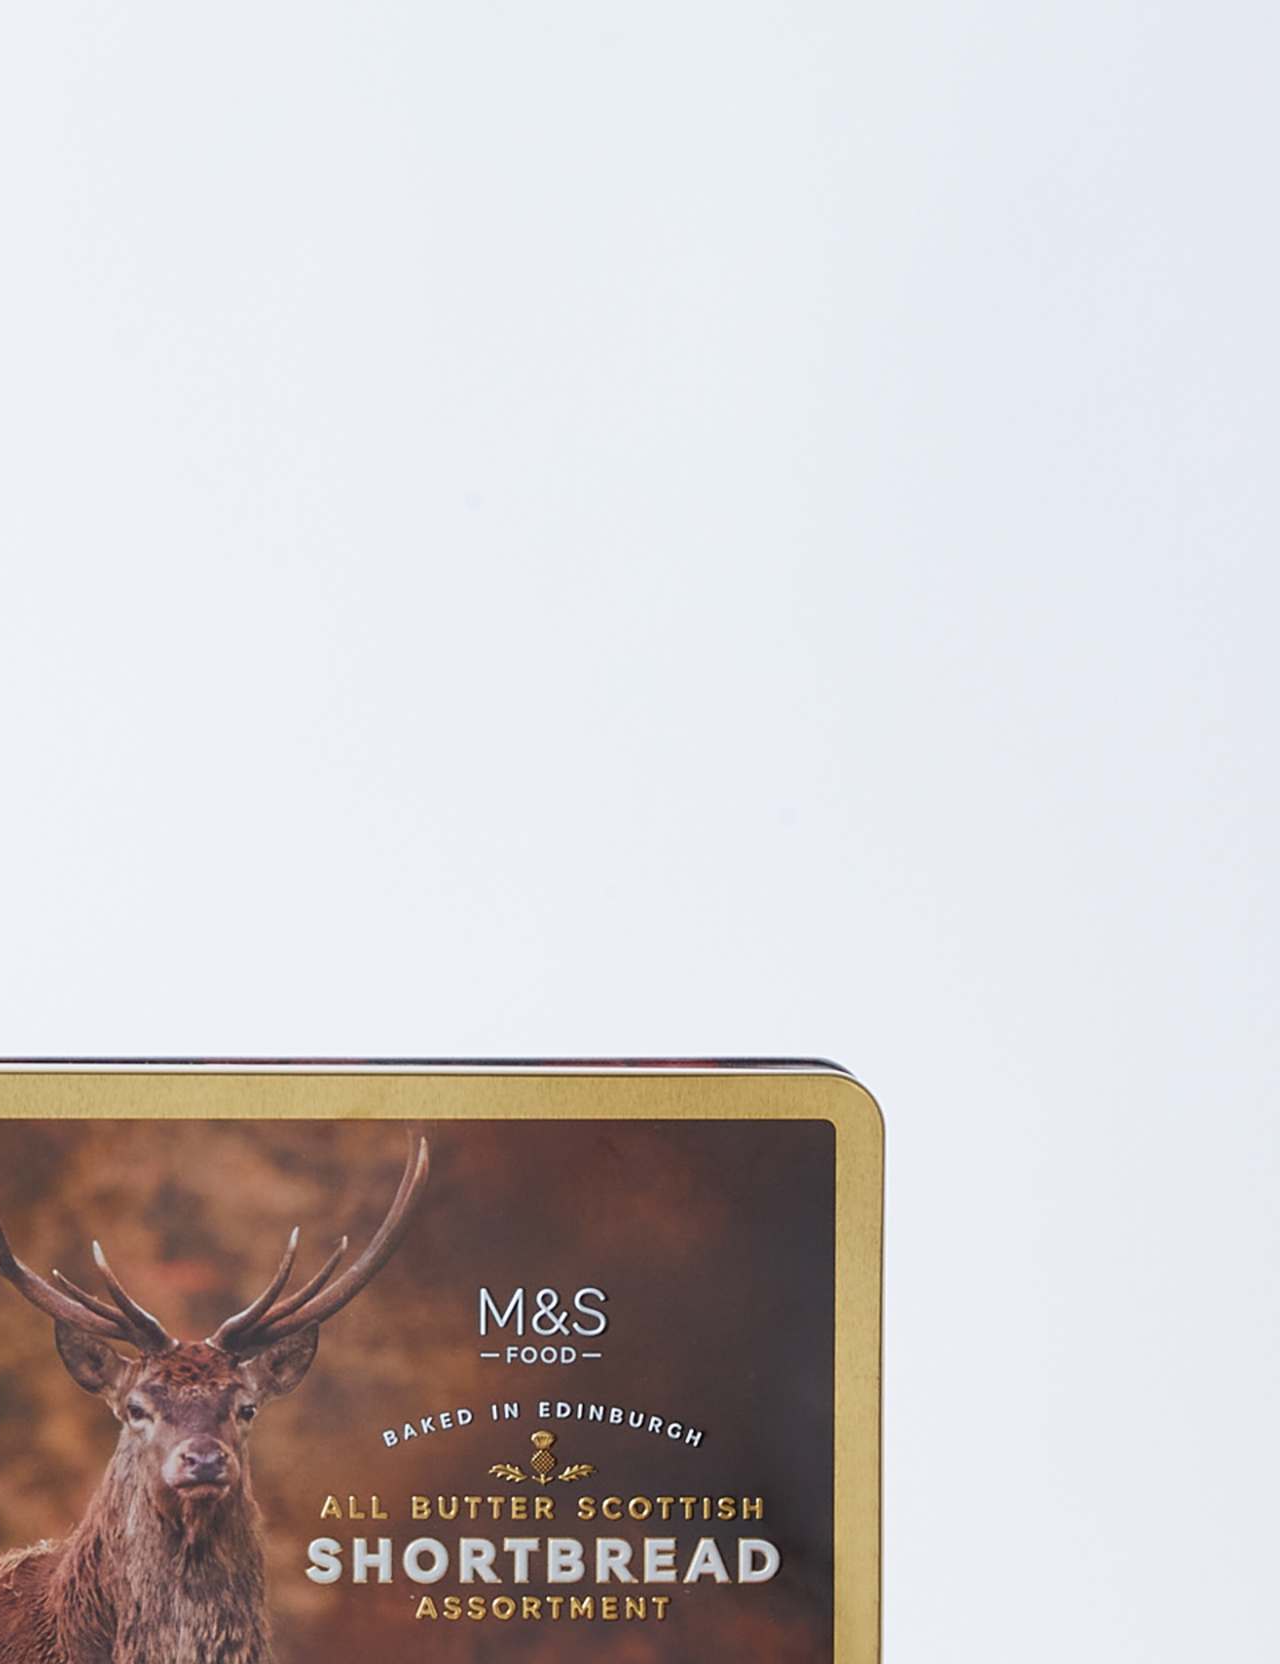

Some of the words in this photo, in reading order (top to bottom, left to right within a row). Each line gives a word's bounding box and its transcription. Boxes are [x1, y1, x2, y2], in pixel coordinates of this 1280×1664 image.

[480, 1287, 608, 1337] M&S
[505, 1346, 577, 1365] FOOD
[382, 1407, 474, 1448] BAKED
[491, 1402, 520, 1421] IN
[538, 1401, 705, 1448] EDINBURGH
[320, 1496, 389, 1520] ALL
[411, 1496, 556, 1520] BUTTER
[577, 1496, 765, 1521] SCOTTISH
[305, 1536, 782, 1585] SHORTBREAD
[415, 1596, 671, 1621] ASSORTMENT
